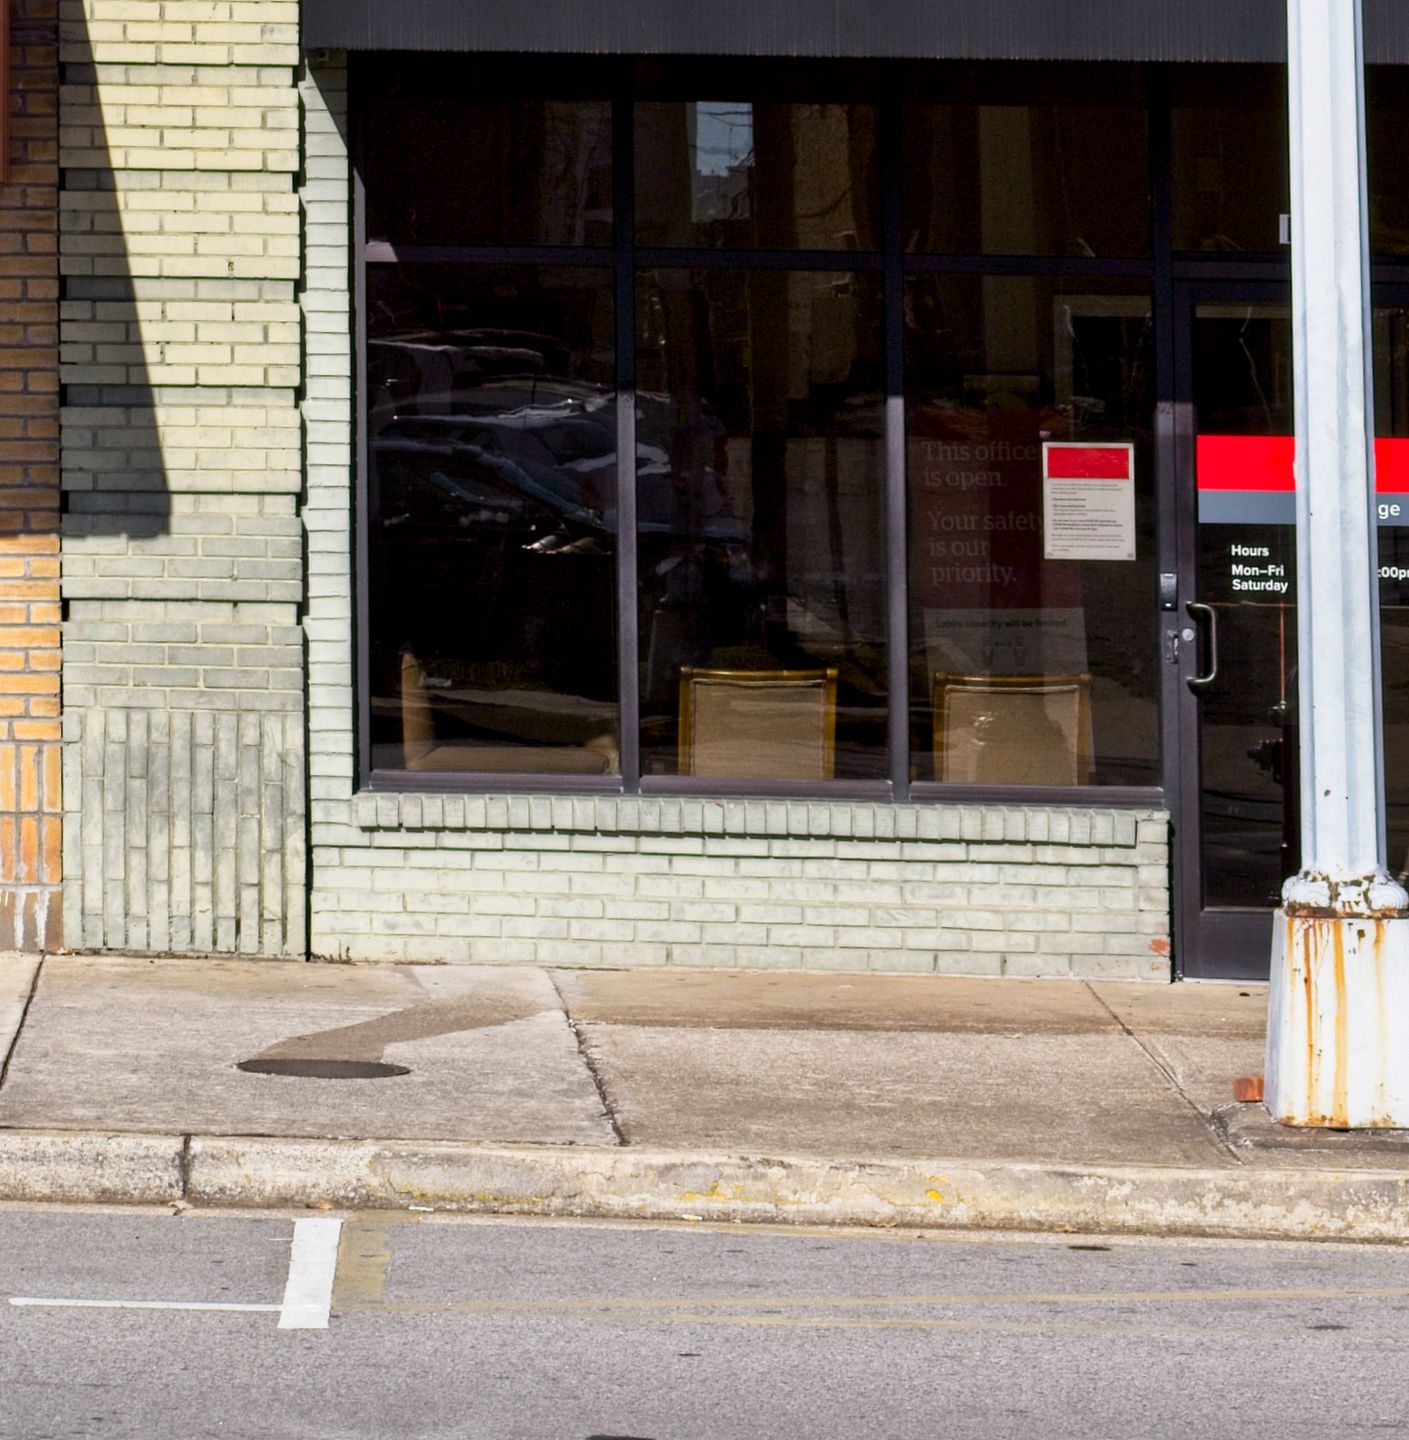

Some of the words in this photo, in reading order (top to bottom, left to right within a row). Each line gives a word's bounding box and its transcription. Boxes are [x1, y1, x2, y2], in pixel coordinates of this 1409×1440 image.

[923, 440, 970, 462] This
[974, 440, 1037, 462] office
[924, 467, 942, 487] is
[946, 470, 1008, 491] open.
[928, 510, 981, 531] Your
[929, 536, 946, 557] is
[951, 540, 990, 557] our
[1231, 544, 1270, 557] Hours
[932, 562, 1018, 586] priority.
[1232, 579, 1289, 594] Saturday
